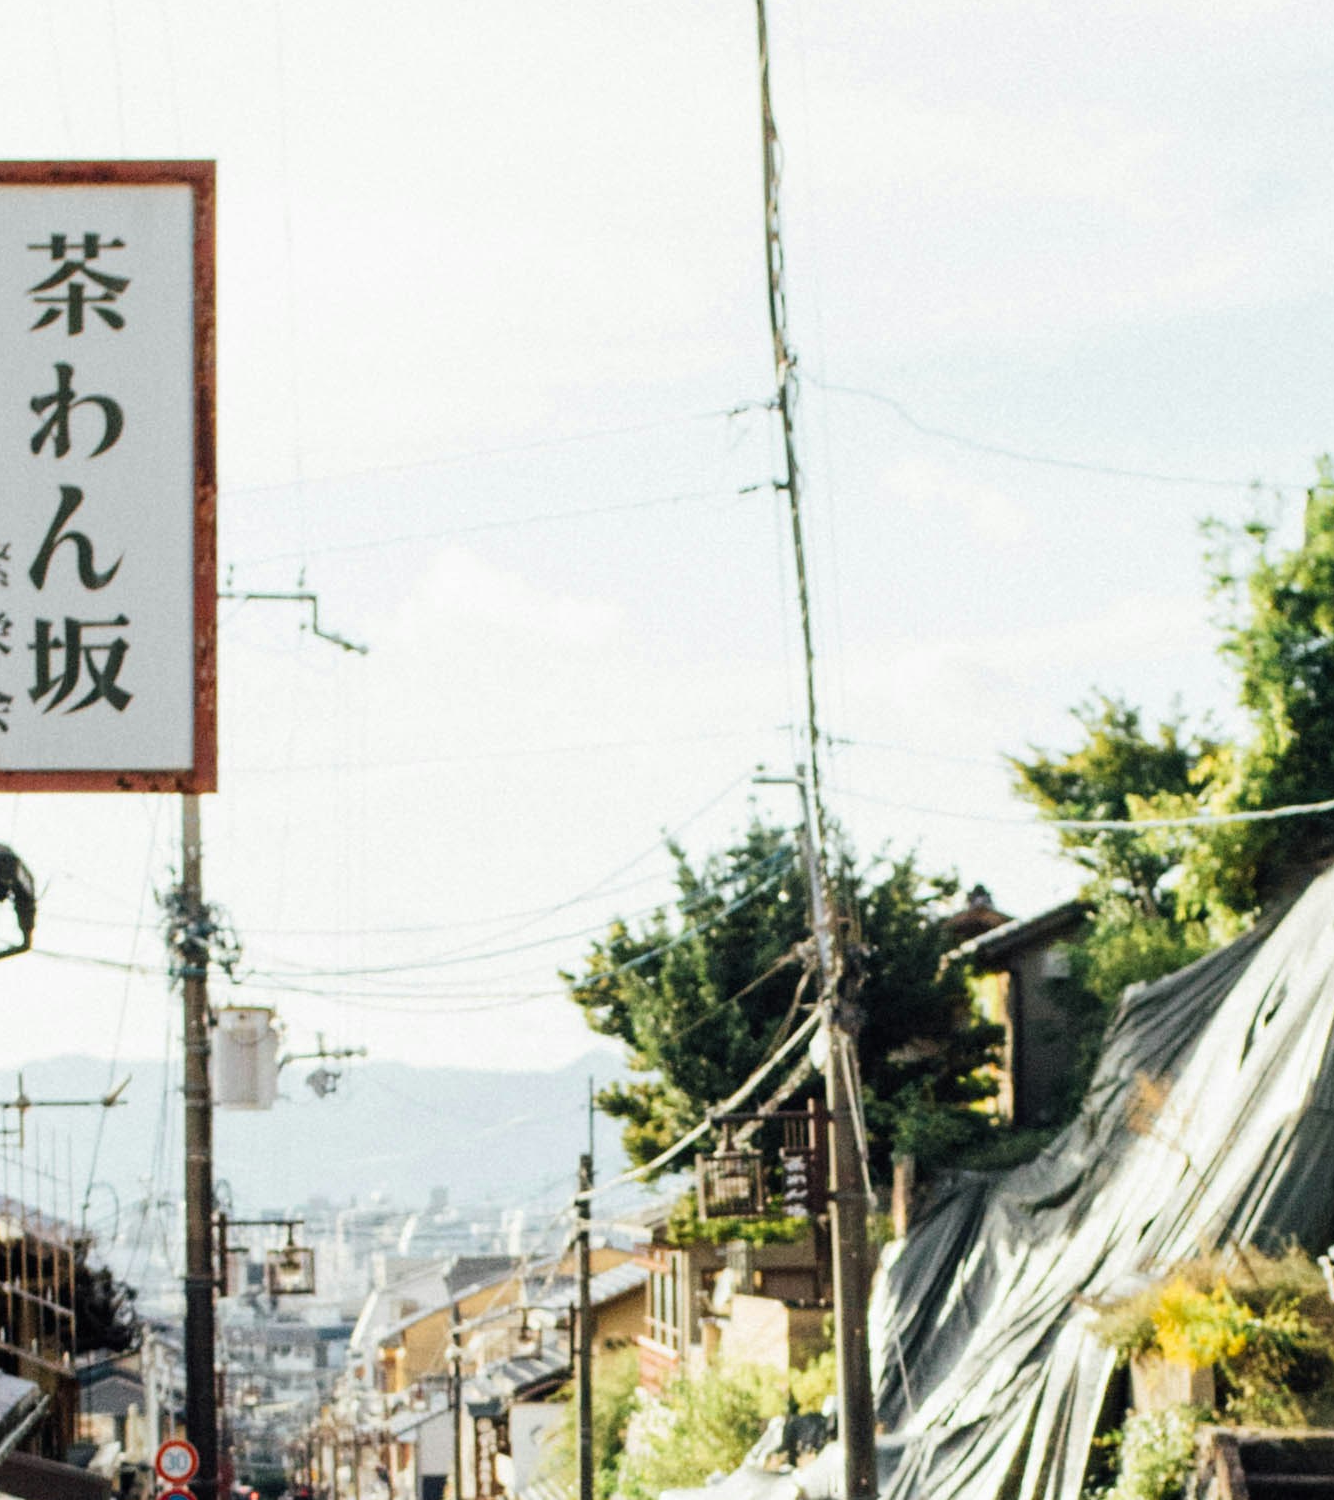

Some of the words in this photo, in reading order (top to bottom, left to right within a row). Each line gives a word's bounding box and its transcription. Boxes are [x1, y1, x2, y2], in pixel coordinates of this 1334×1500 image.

[26, 232, 134, 716] 茶わん坂
[164, 1452, 190, 1472] 30
